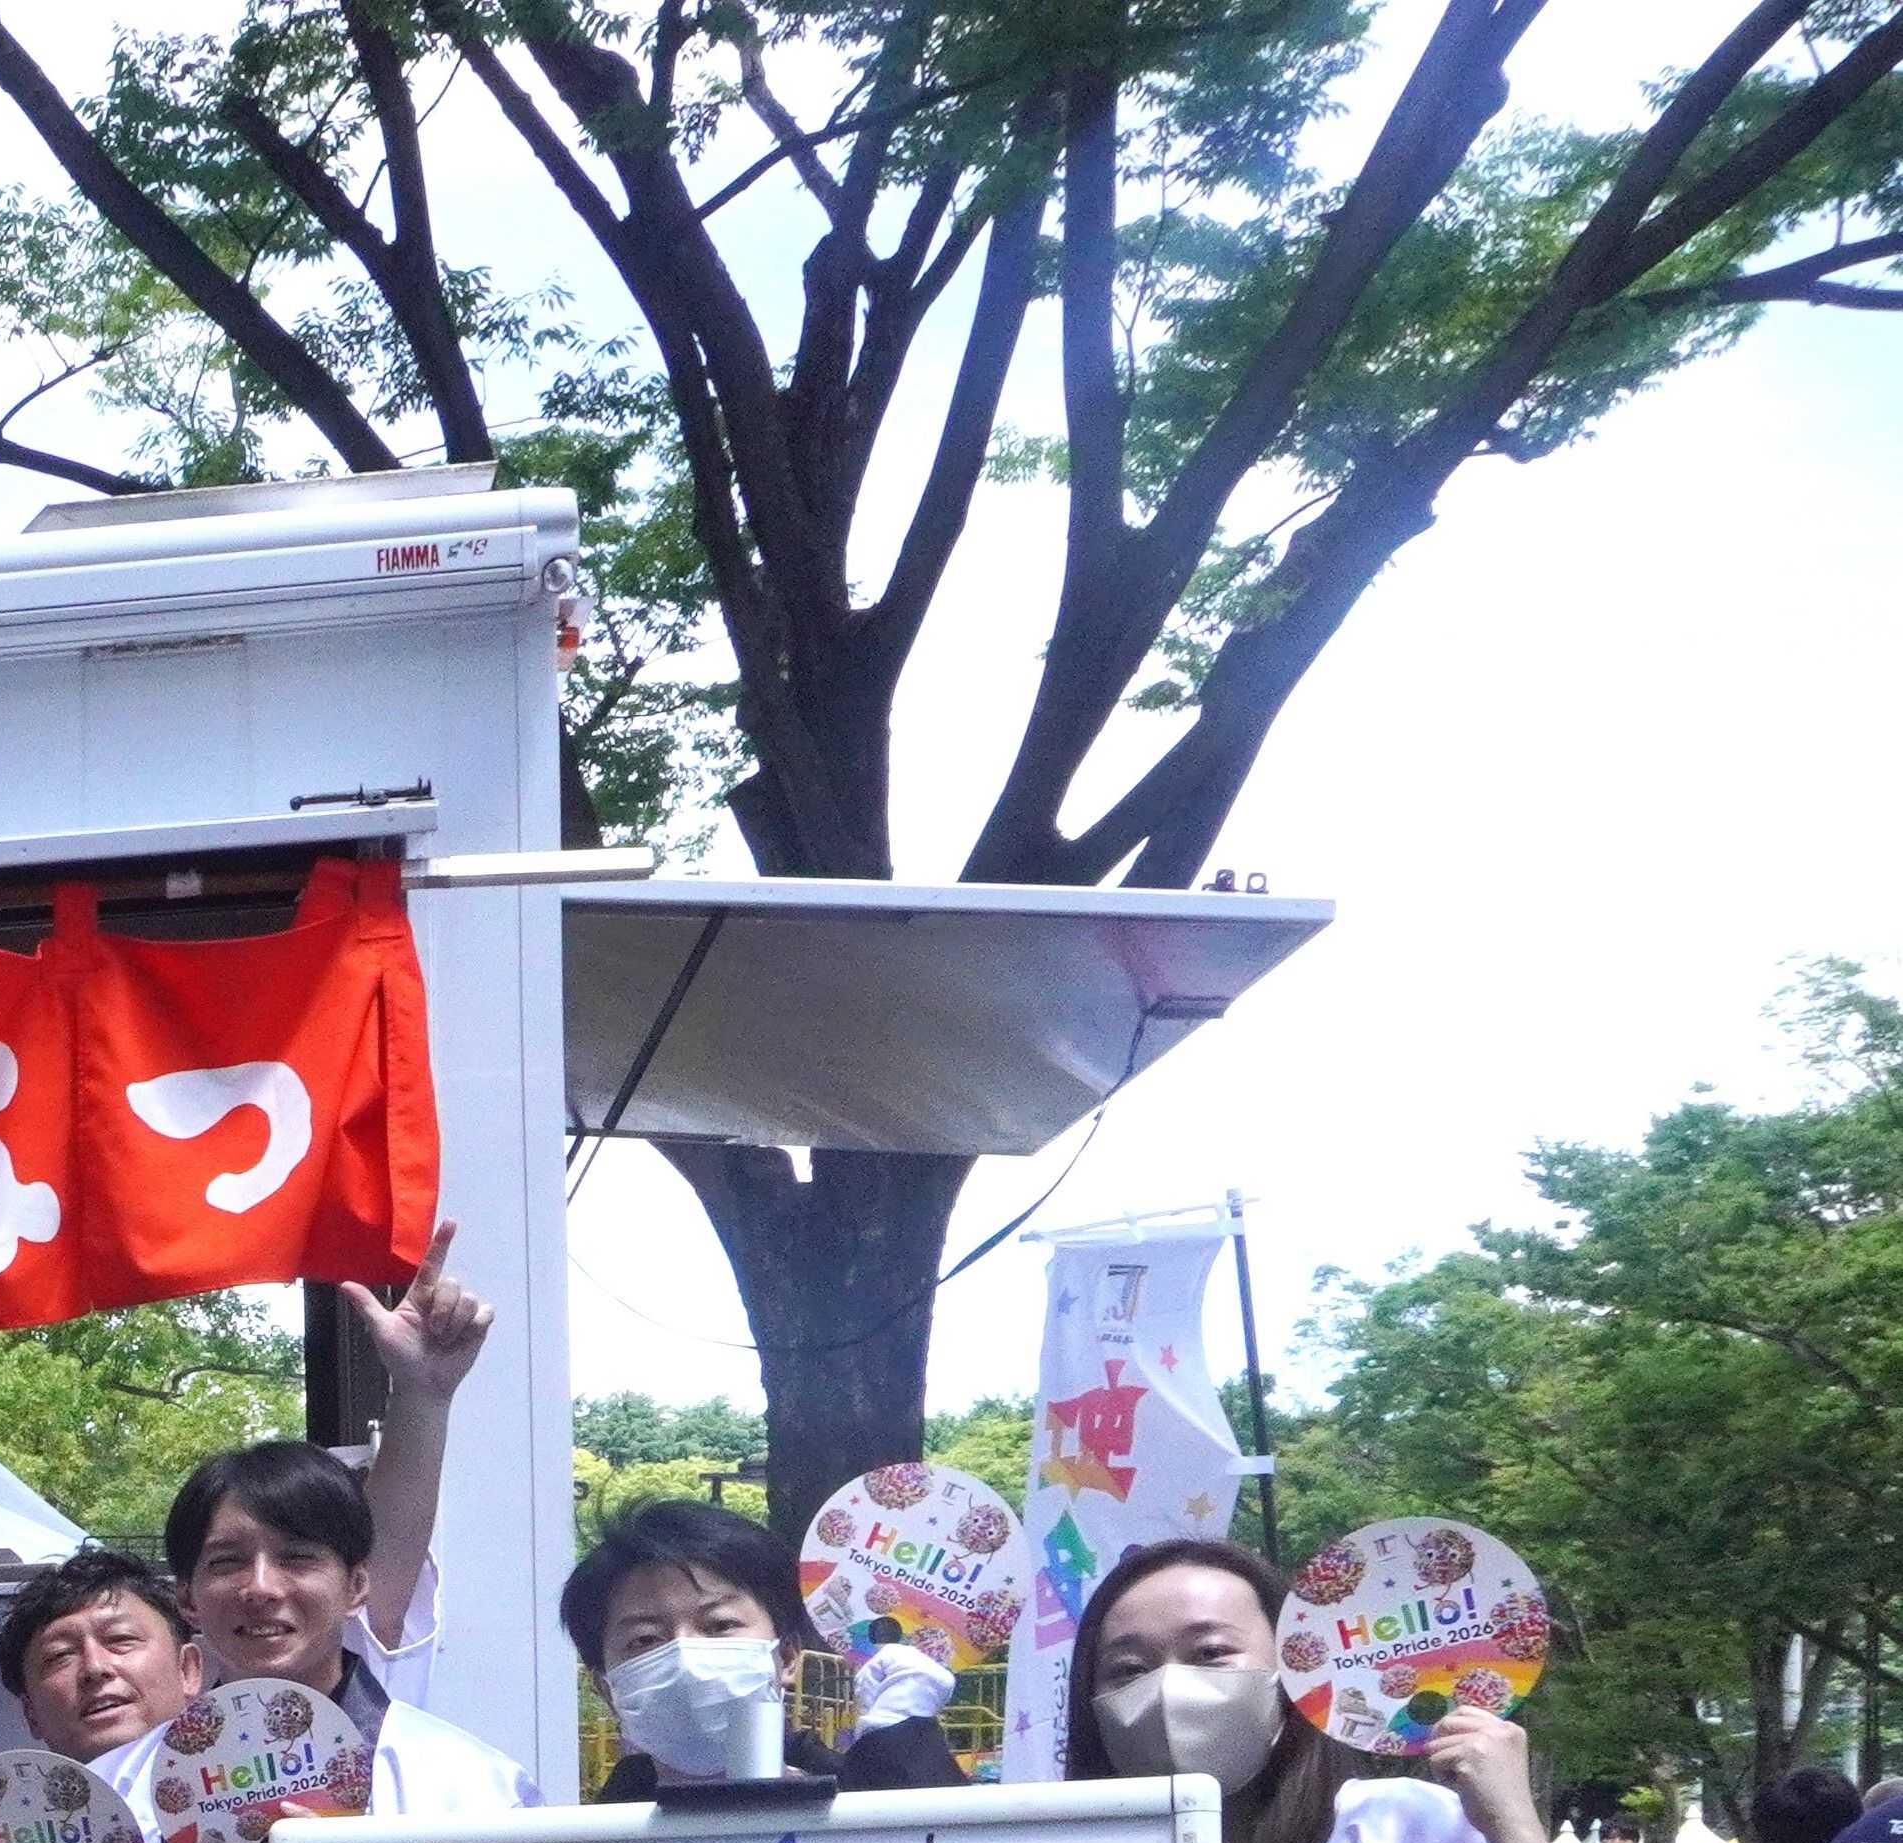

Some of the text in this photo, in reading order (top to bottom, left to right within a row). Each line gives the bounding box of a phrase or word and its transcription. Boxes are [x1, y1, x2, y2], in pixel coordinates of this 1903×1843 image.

[377, 544, 439, 573] FIAMMA
[849, 1548, 975, 1610] Tokyo Pride 2026
[865, 1521, 983, 1590] Hello!
[1336, 1588, 1478, 1650] Hello!
[1333, 1624, 1494, 1670] Tokyo Pride 2026
[198, 1774, 328, 1815] Tokyo Pride 2026
[200, 1743, 315, 1795] Hello!
